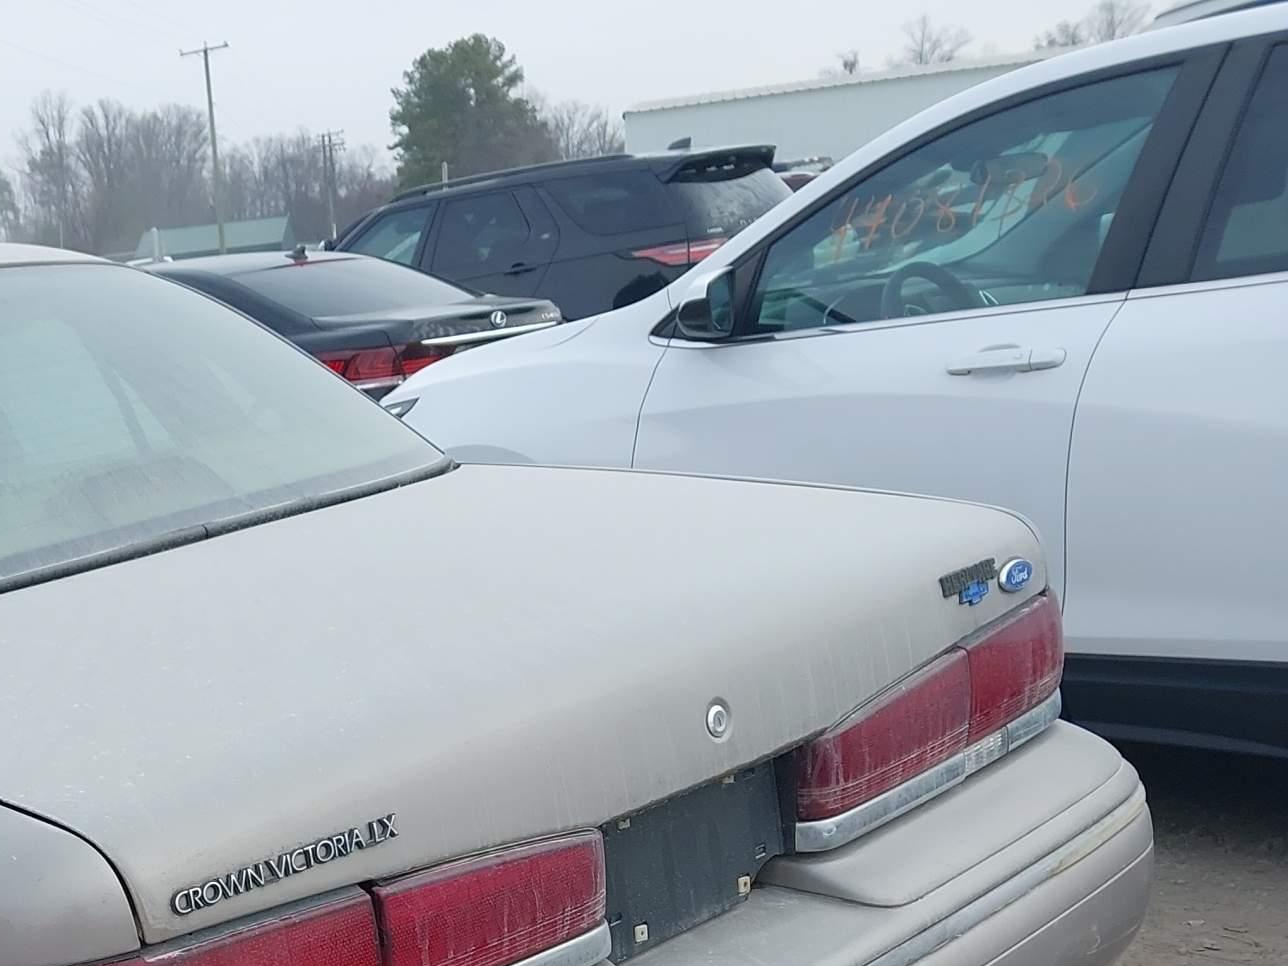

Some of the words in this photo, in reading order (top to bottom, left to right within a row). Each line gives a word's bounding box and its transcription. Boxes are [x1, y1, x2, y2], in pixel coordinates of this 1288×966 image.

[171, 862, 265, 916] CROWN
[266, 827, 367, 880] VICTORIA
[367, 812, 399, 846] LX
